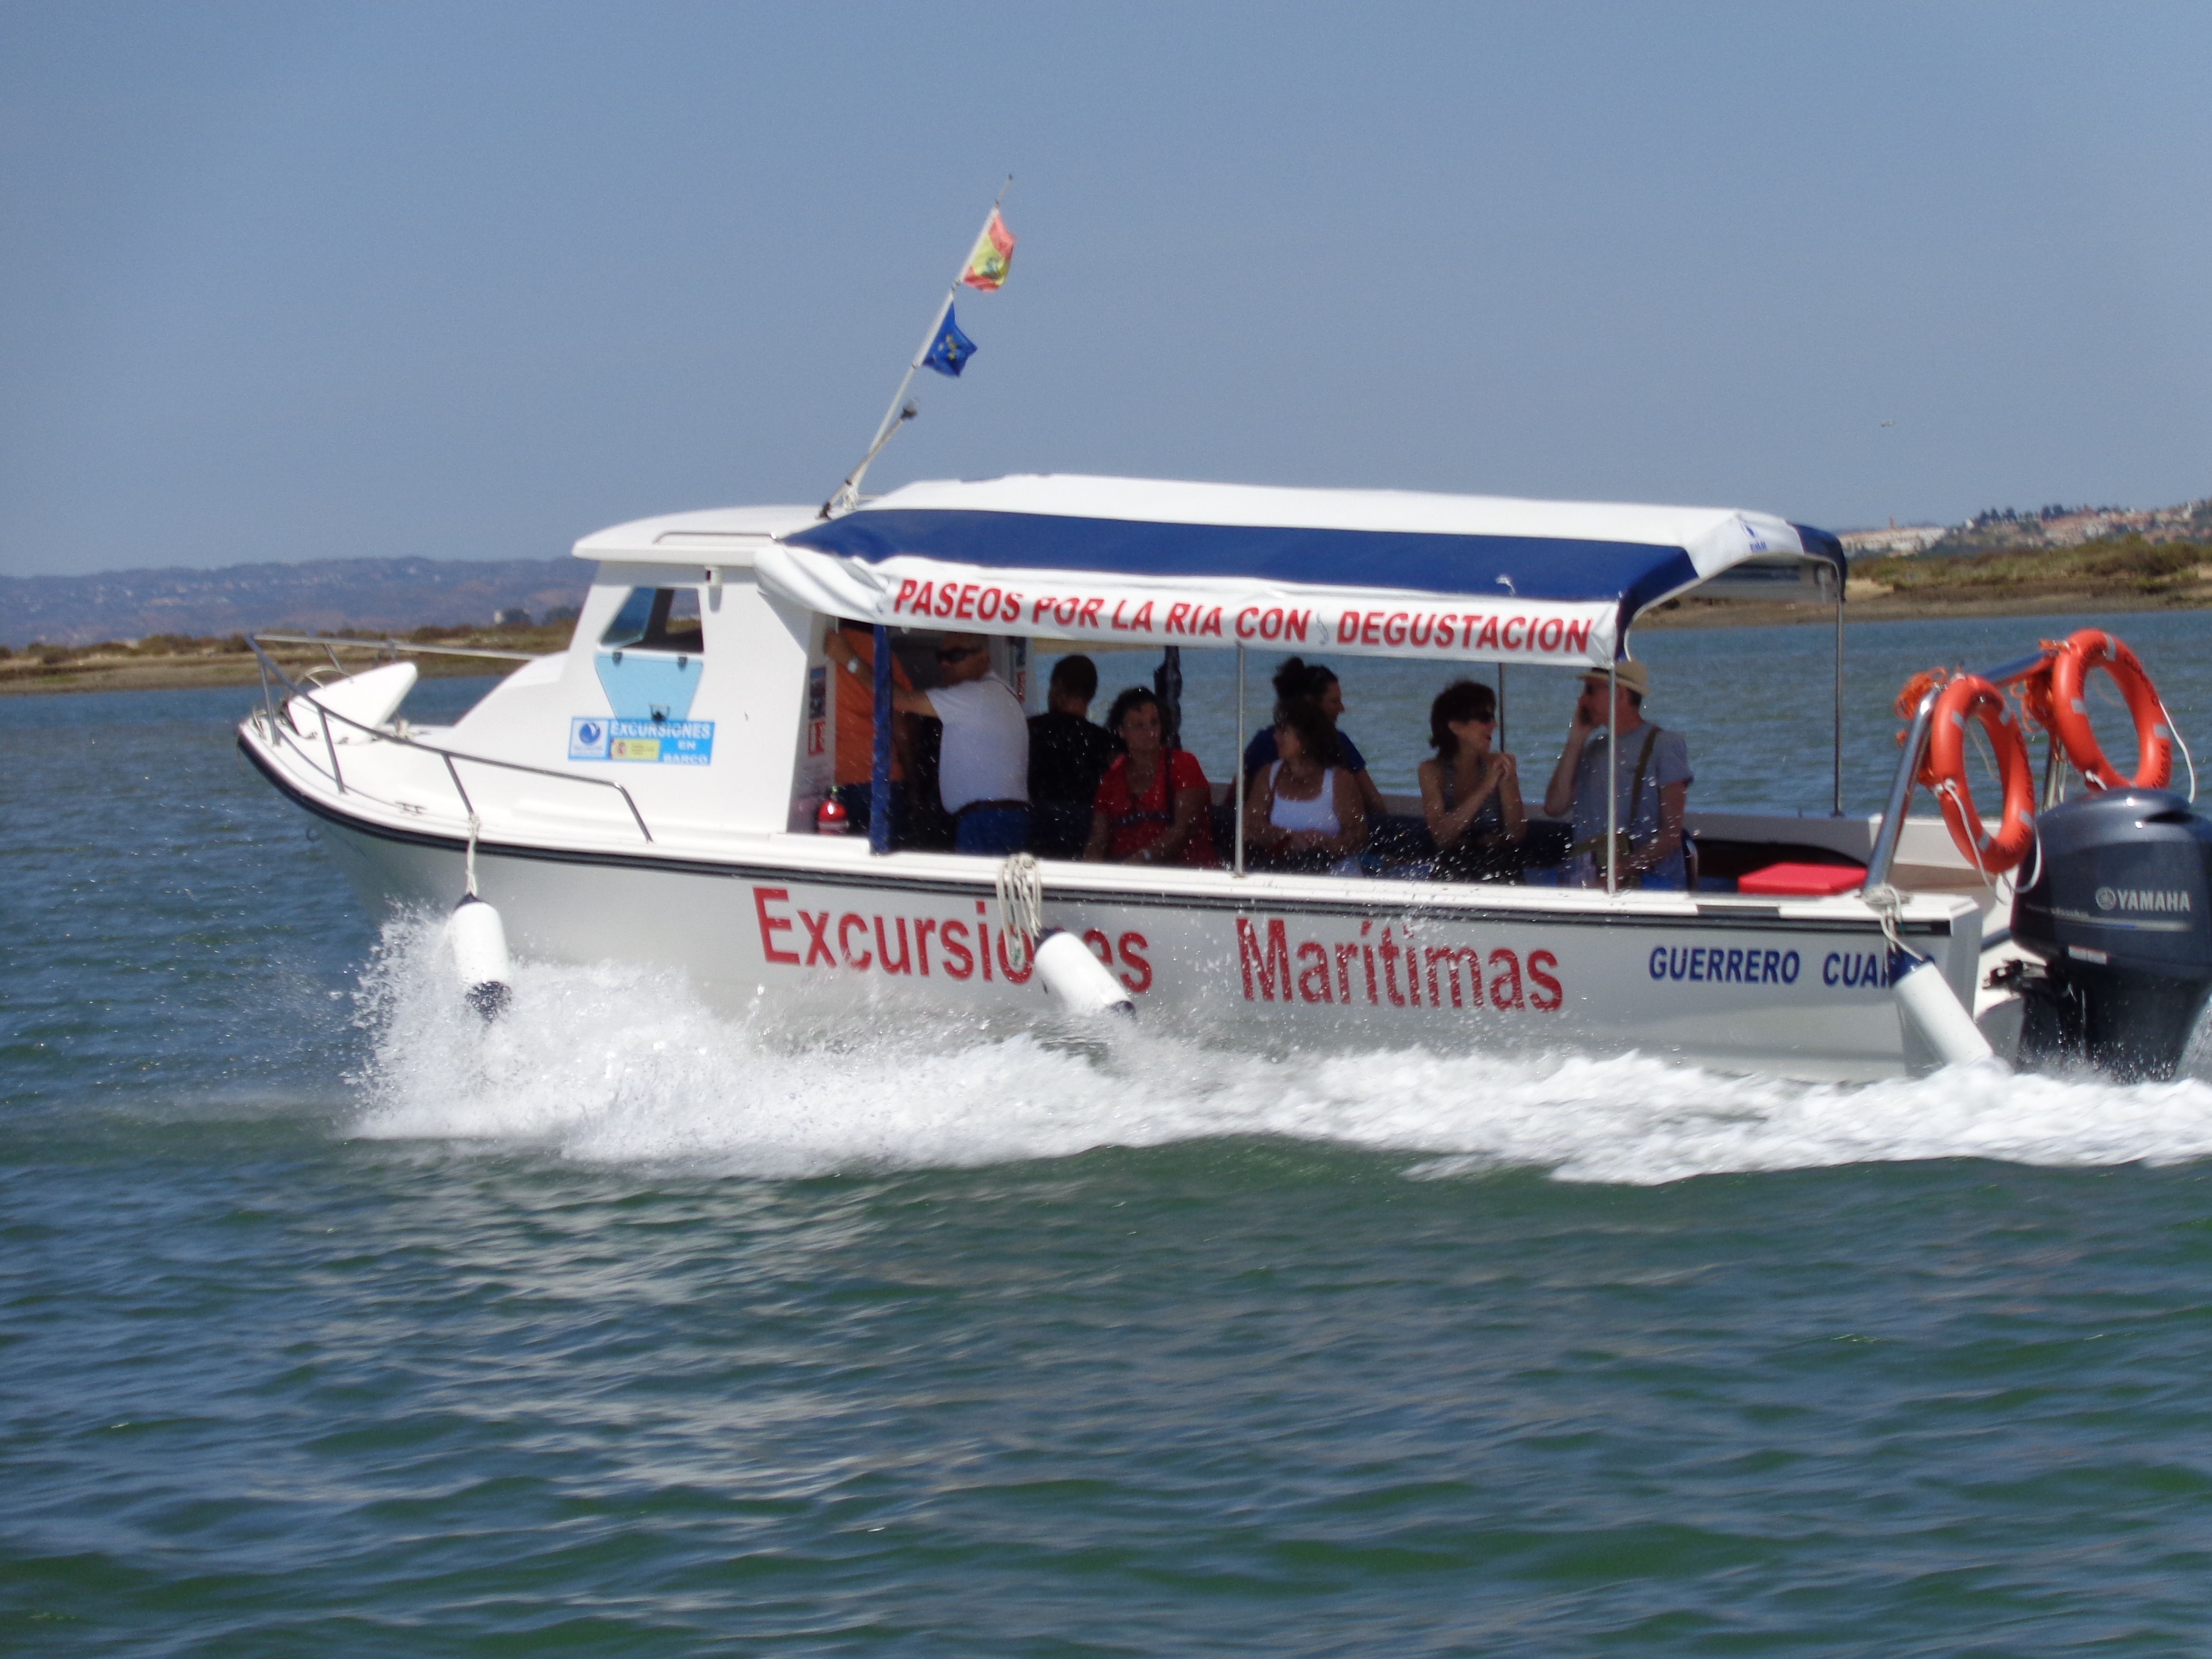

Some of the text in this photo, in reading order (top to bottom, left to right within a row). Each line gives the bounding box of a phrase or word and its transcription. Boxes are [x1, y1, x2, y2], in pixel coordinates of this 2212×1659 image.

[893, 578, 1594, 653] PASEOS POR LA RIA CON DEGUSTACION
[609, 722, 711, 739] EXCURSIONES
[678, 739, 696, 750] EN
[2117, 890, 2191, 912] YAMAHA
[753, 886, 1563, 1012] Excursioes Marítimas
[1649, 946, 1800, 984] GUERRERO
